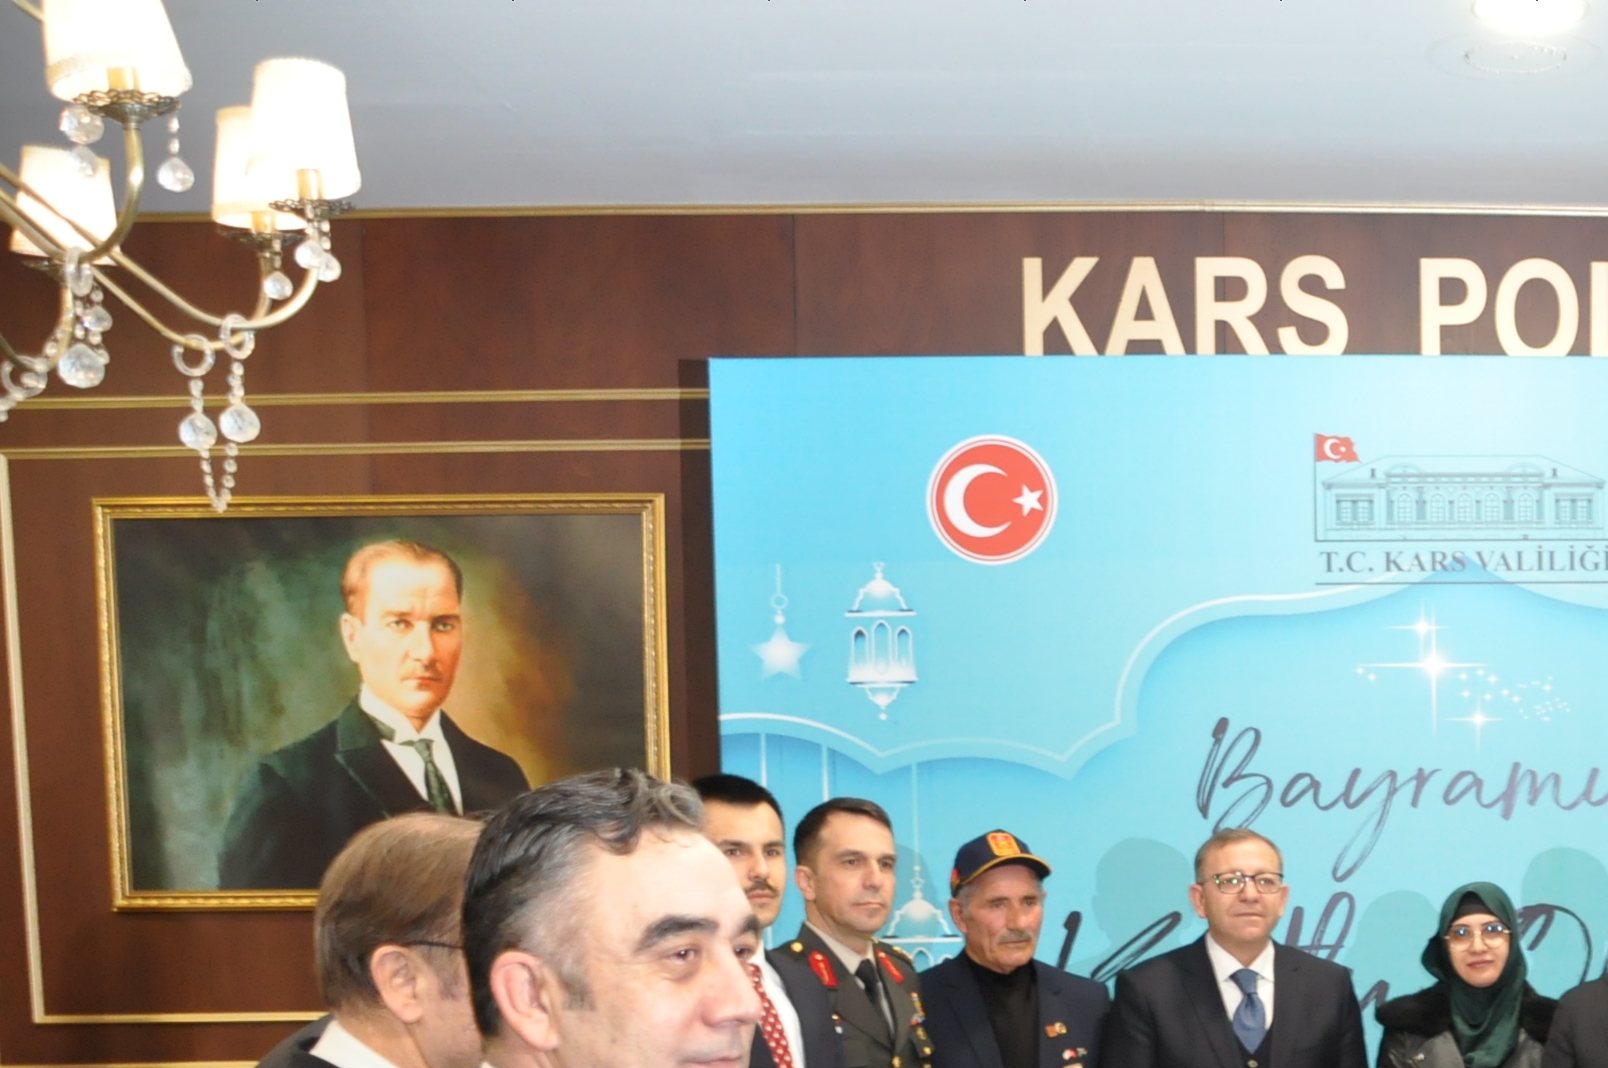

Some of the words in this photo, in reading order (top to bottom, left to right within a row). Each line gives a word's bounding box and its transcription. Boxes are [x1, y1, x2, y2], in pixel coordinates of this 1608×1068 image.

[1022, 254, 1349, 356] KARS
[1319, 550, 1374, 573] T.C.
[1384, 550, 1466, 573] KARS
